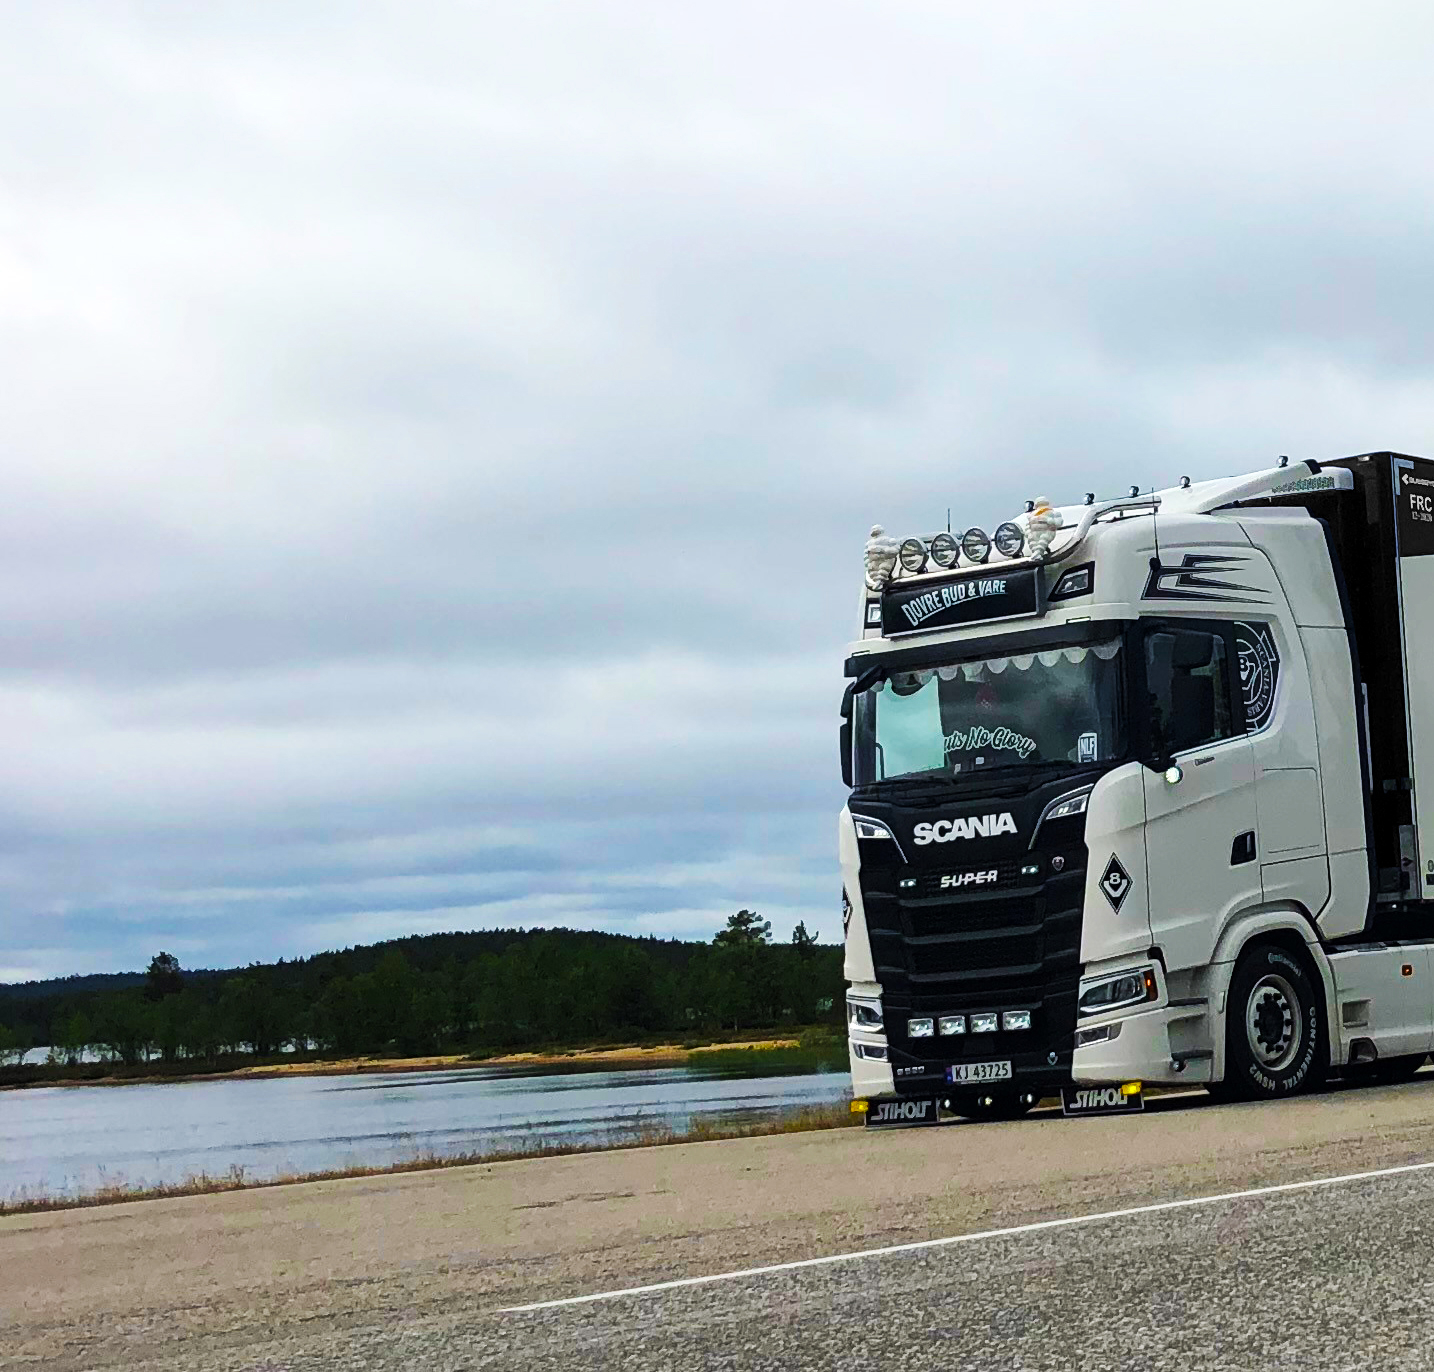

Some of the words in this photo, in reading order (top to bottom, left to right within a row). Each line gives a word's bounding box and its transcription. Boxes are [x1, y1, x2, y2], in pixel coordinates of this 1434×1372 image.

[1409, 494, 1433, 512] FRC
[901, 588, 942, 626] DOVRE
[941, 584, 966, 608] BUD
[968, 581, 977, 597] &
[978, 579, 1007, 597] VARE
[944, 730, 967, 753] uts
[966, 726, 992, 750] No
[992, 726, 1036, 759] Glory
[913, 812, 1018, 846] SCANIA
[940, 869, 998, 888] SUPER
[955, 1065, 969, 1080] KJ
[973, 1063, 1009, 1079] 43725
